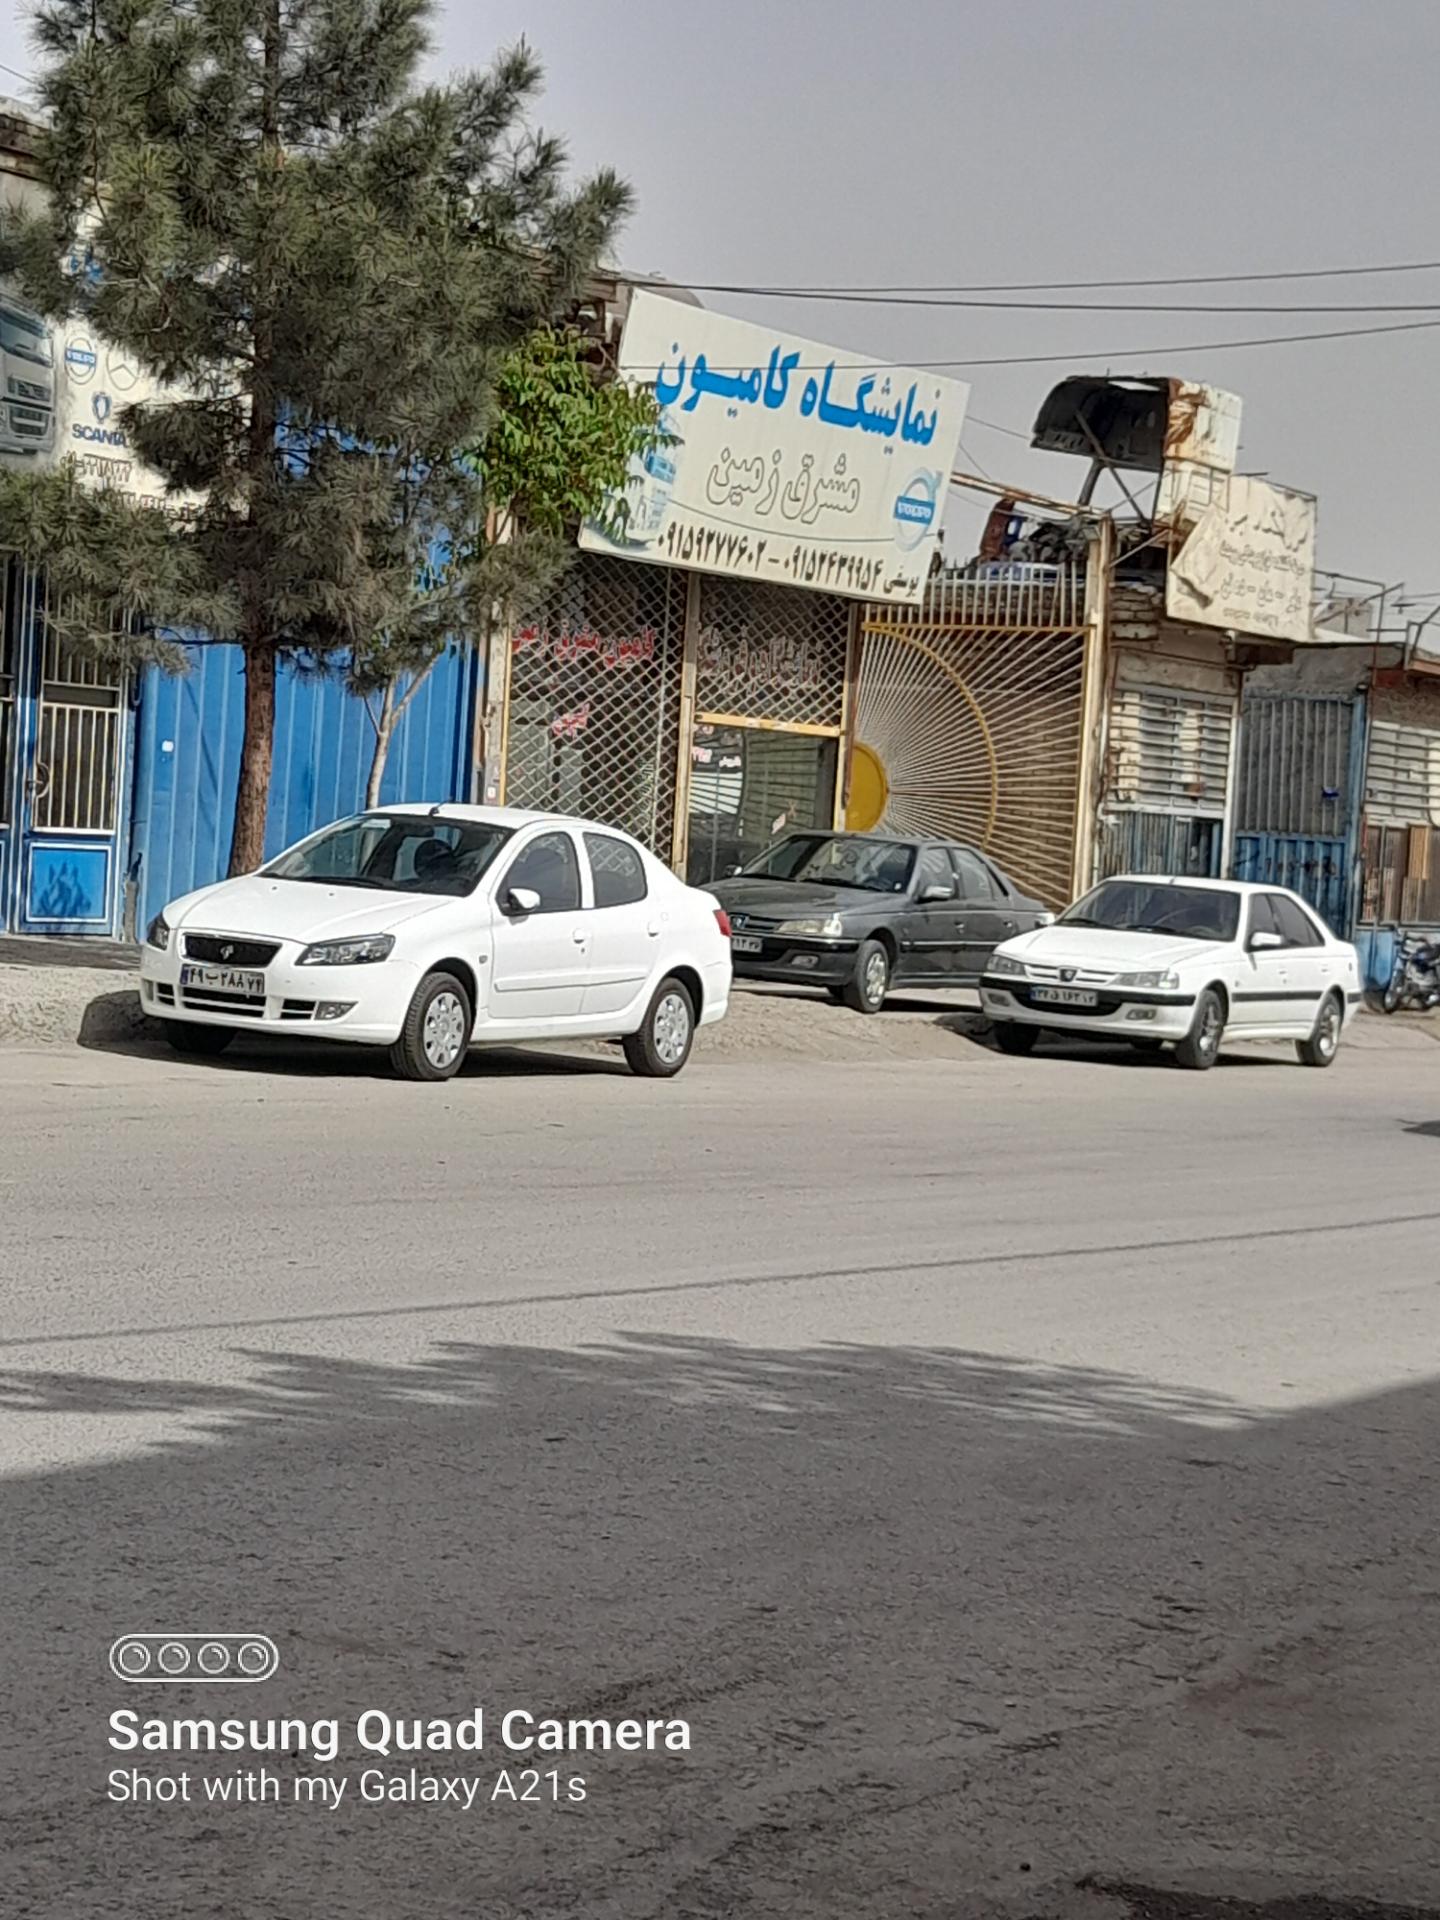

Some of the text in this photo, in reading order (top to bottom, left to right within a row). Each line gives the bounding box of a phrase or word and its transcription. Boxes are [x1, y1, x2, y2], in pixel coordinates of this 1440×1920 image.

[71, 423, 127, 448] SCANIA
[654, 341, 942, 455] نمایشگاه کامیون
[706, 447, 861, 525] مشرق زمین
